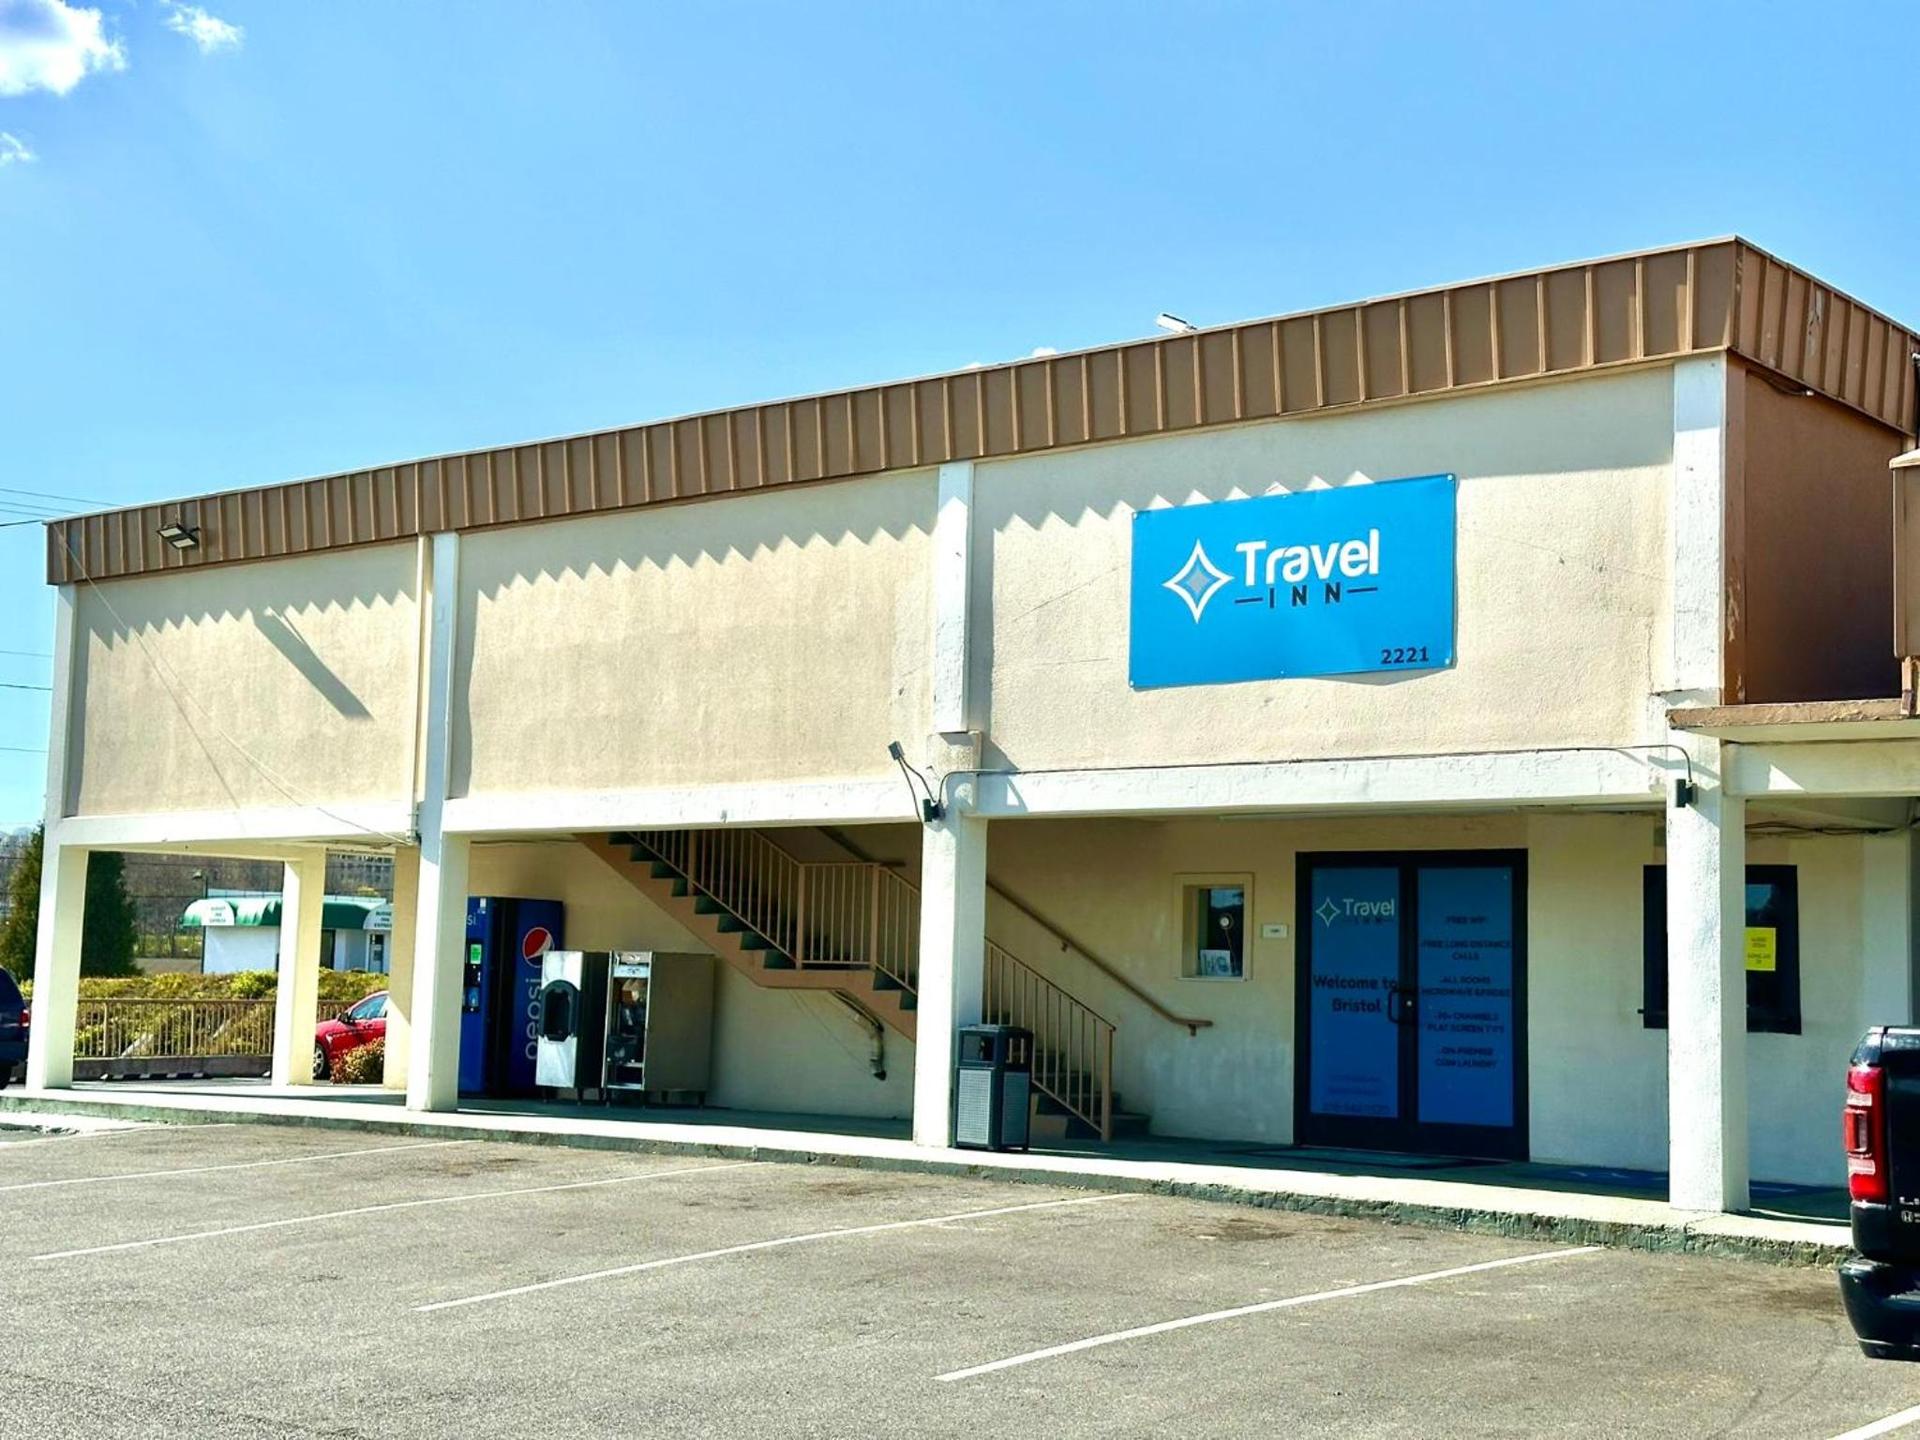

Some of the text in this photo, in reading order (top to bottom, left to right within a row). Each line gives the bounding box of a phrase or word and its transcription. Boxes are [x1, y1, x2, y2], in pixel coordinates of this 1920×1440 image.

[1234, 528, 1380, 587] Travel
[1268, 581, 1342, 609] INN
[1380, 645, 1430, 665] 2221
[1343, 898, 1395, 916] Travel
[1451, 951, 1481, 961] CALLS
[1312, 974, 1378, 990] Welcome
[1332, 997, 1382, 1013] Bristol
